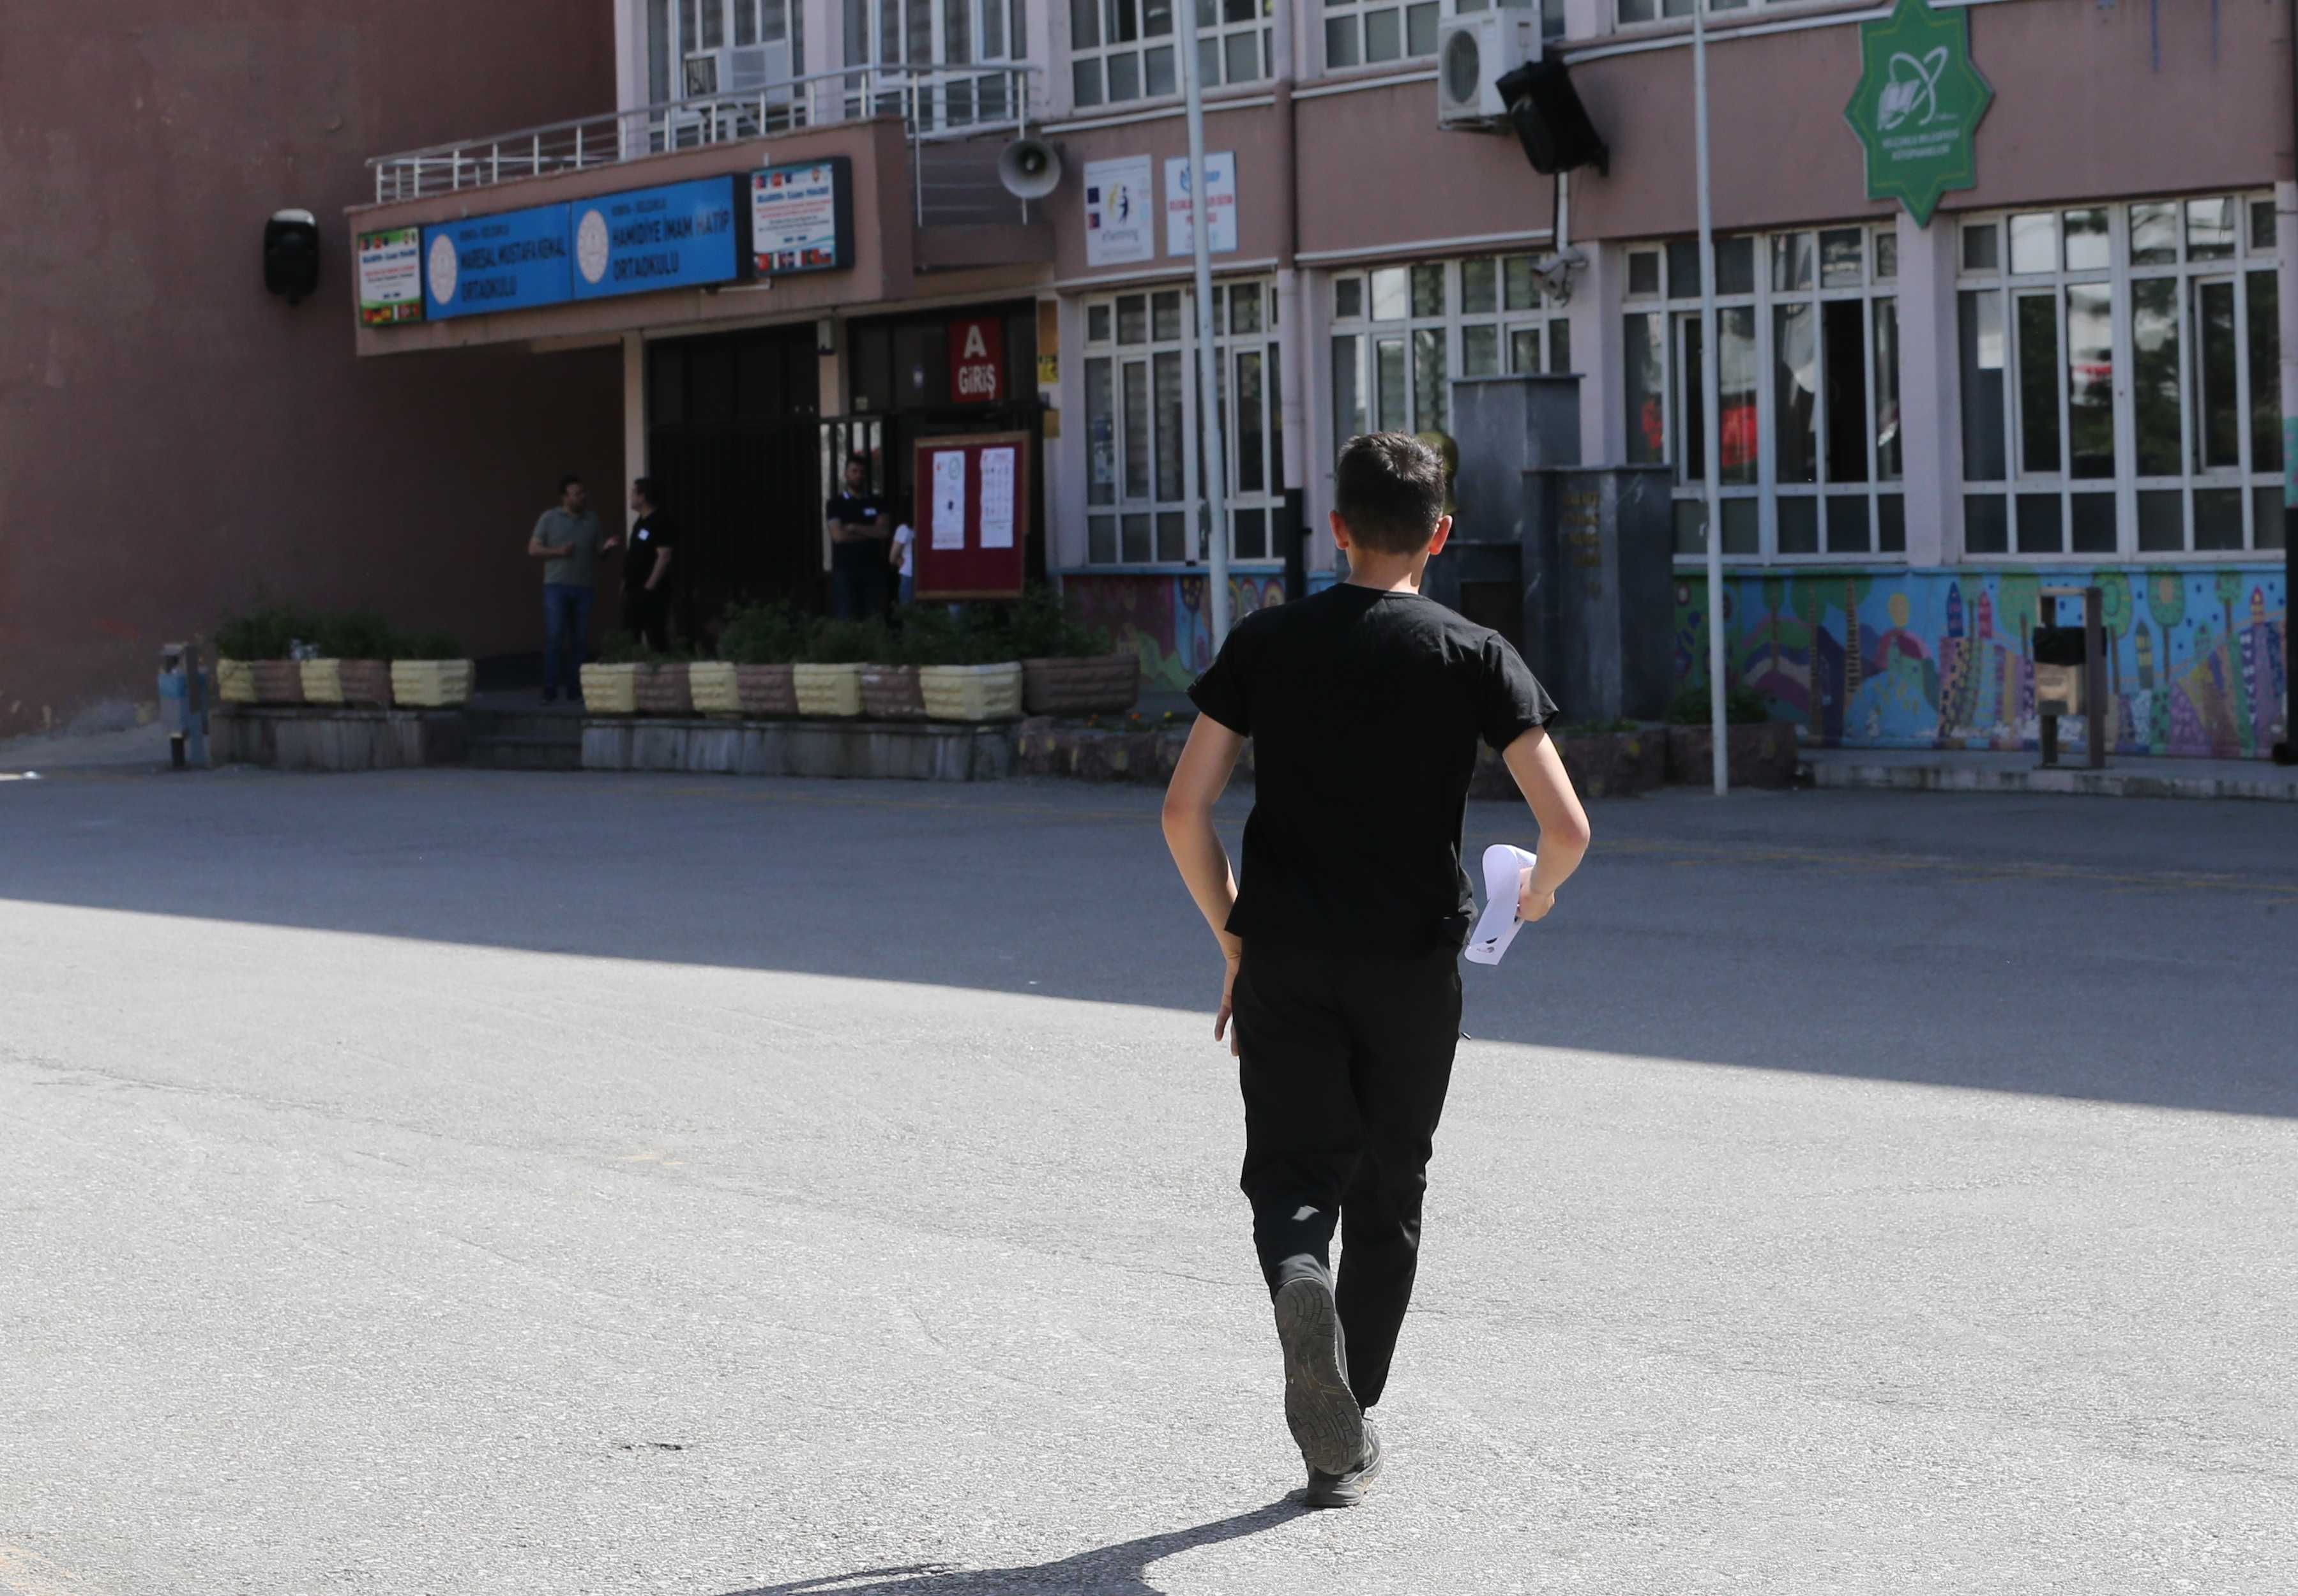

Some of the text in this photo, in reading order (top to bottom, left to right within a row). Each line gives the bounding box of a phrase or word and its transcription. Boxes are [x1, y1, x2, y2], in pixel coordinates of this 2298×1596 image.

[664, 213, 694, 241] İMAM
[697, 206, 729, 236] HATİP
[613, 251, 679, 282] ORTAOKULU
[964, 324, 986, 359] A
[958, 364, 996, 400] GİRİŞ
